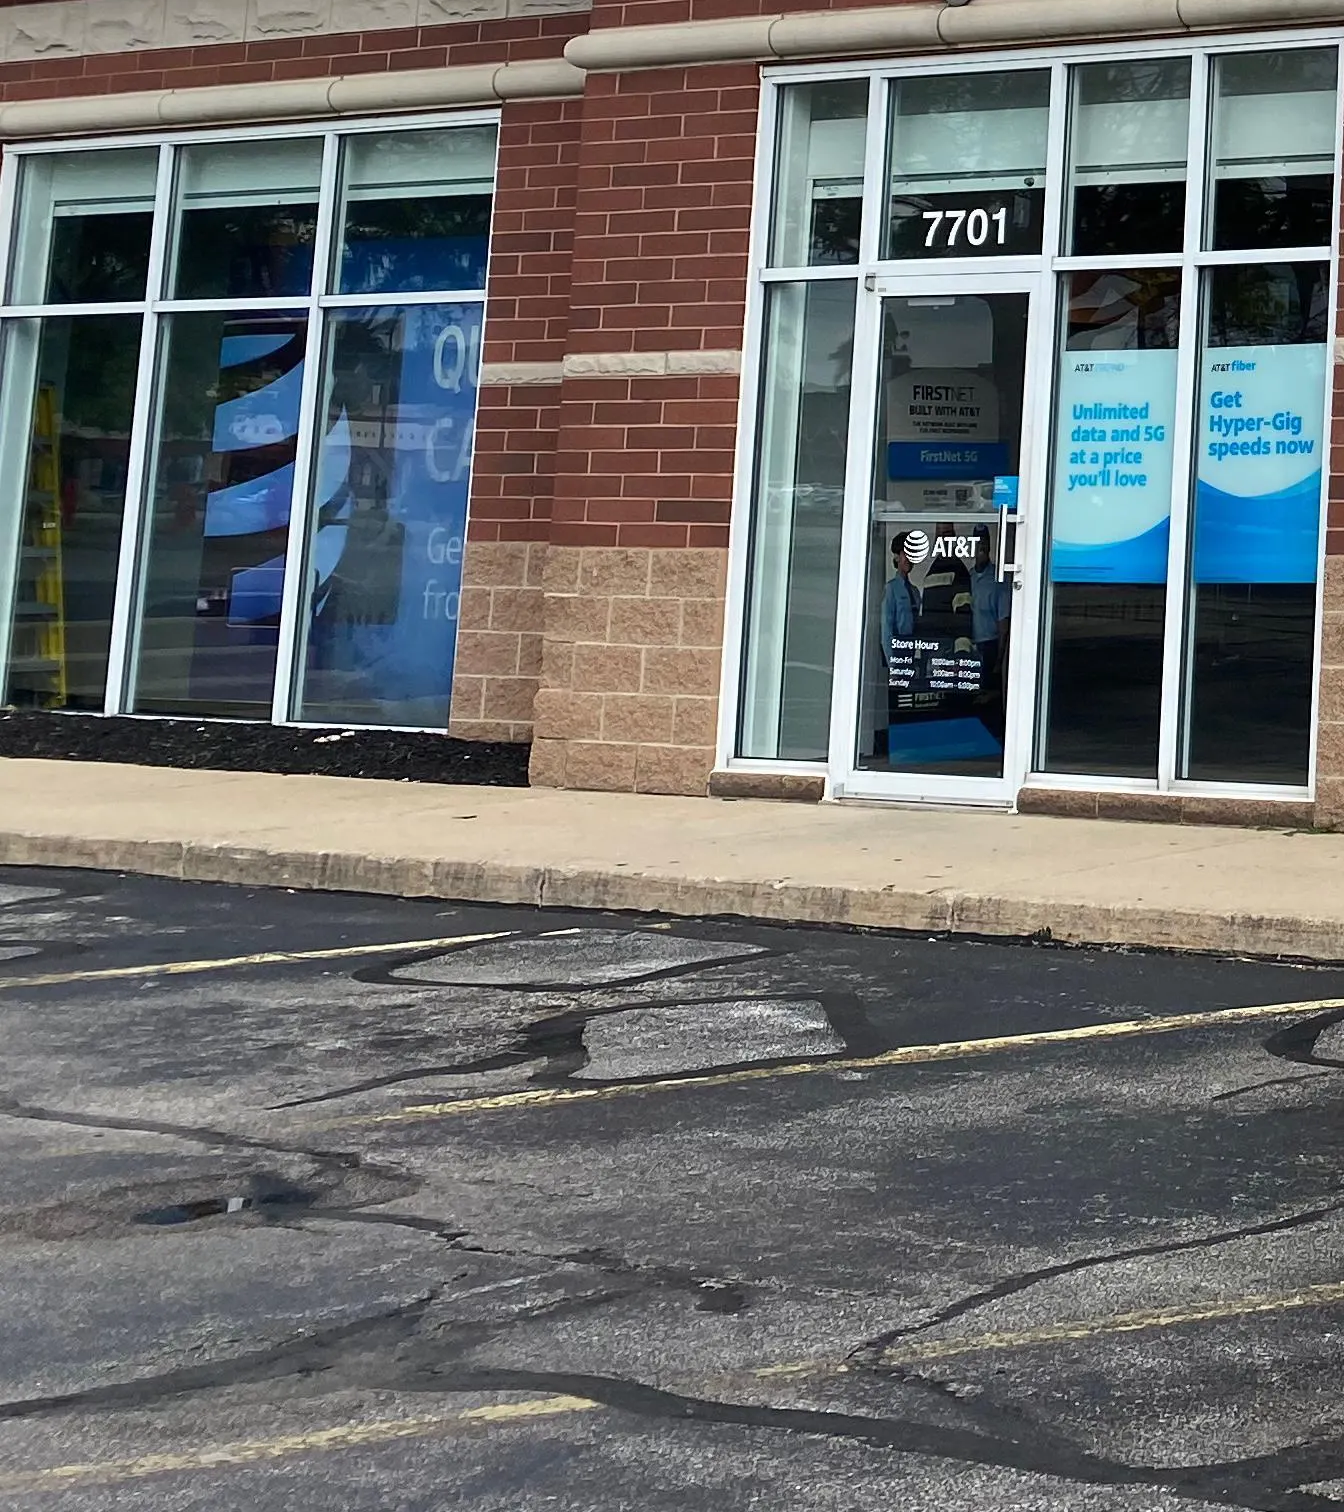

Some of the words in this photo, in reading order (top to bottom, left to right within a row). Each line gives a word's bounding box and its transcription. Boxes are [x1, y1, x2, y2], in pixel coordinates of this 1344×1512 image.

[922, 207, 1006, 247] 7701
[1074, 363, 1095, 373] AT&T
[1211, 363, 1230, 372] AT&T
[1231, 360, 1256, 372] fiber
[1210, 391, 1242, 408] Get
[1073, 402, 1149, 420] Unlimited
[1071, 426, 1107, 442] data
[1111, 425, 1139, 442] and
[1144, 425, 1164, 441] 5G
[1209, 412, 1302, 436] Hyper-Gig
[1070, 450, 1087, 464] at
[1090, 452, 1099, 464] a
[1103, 447, 1142, 468] price
[1208, 437, 1271, 461] speeds
[1275, 439, 1314, 455] now
[1068, 470, 1110, 491] you'll
[1115, 471, 1147, 486] love
[931, 536, 980, 558] AT&T
[891, 639, 914, 649] Store
[915, 640, 939, 650] Hours
